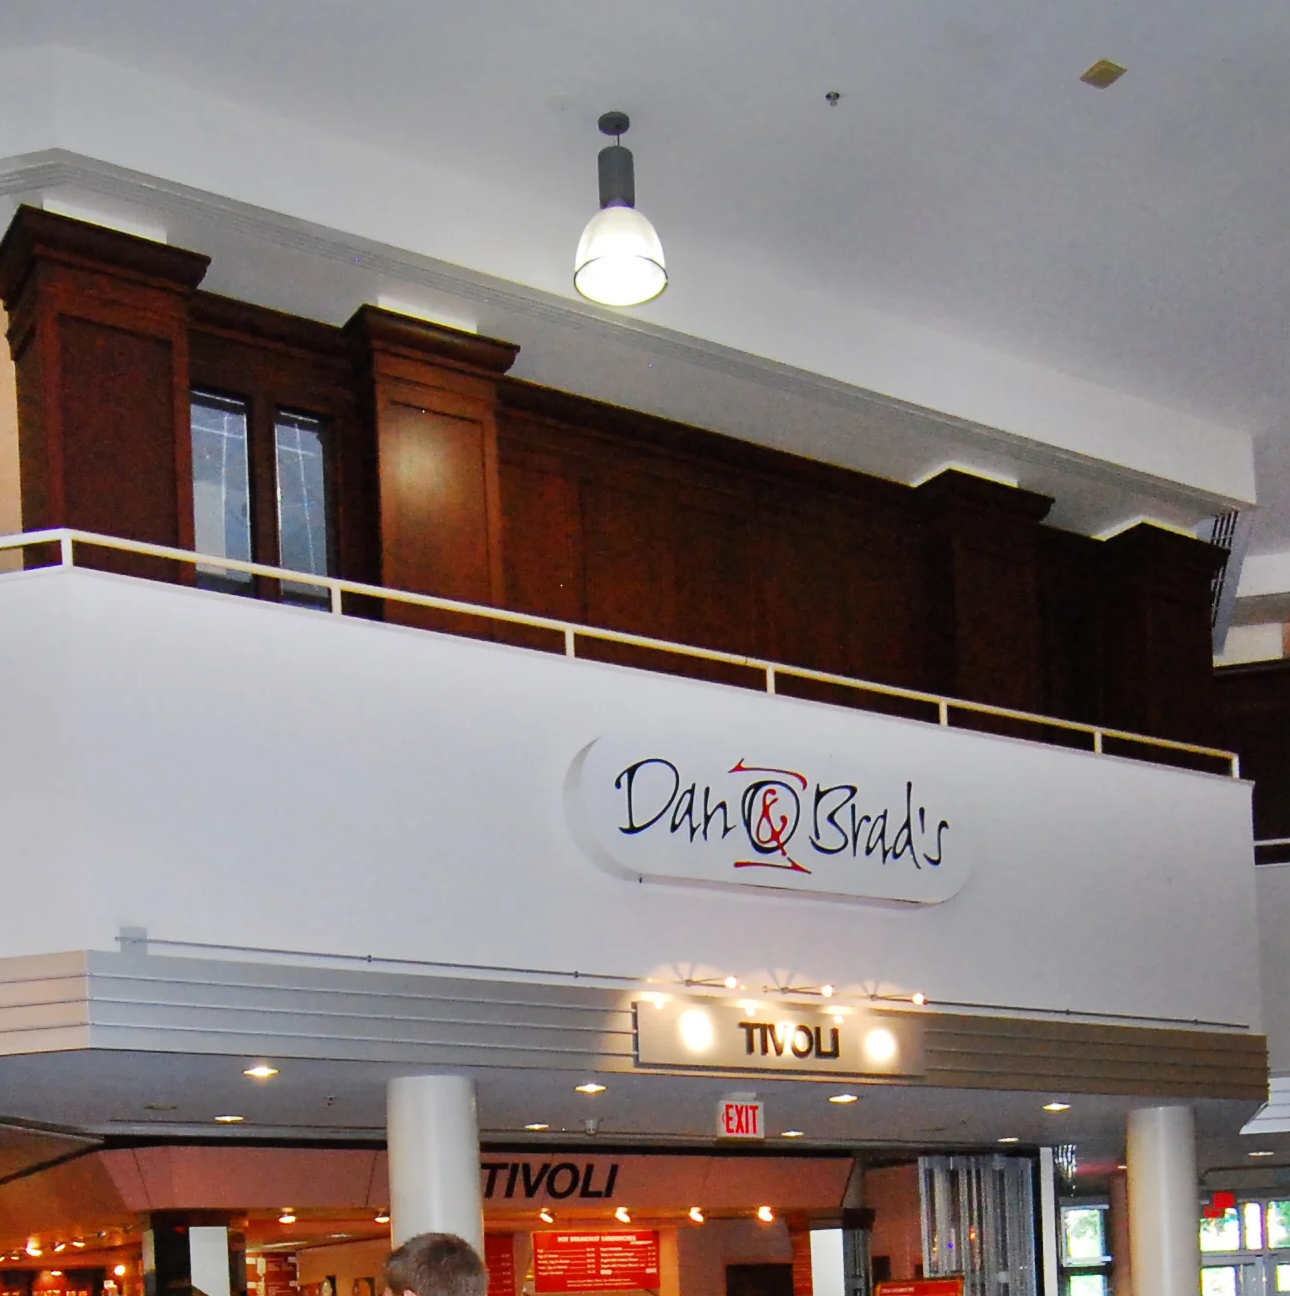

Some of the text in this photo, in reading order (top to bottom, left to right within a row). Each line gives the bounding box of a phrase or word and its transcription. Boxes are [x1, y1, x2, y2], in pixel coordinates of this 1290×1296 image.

[614, 758, 736, 843] Dan
[810, 780, 950, 870] Brad's
[738, 1021, 840, 1060] TIVOLI
[724, 1103, 760, 1135] EXIT
[480, 1161, 619, 1200] TIVOLI
